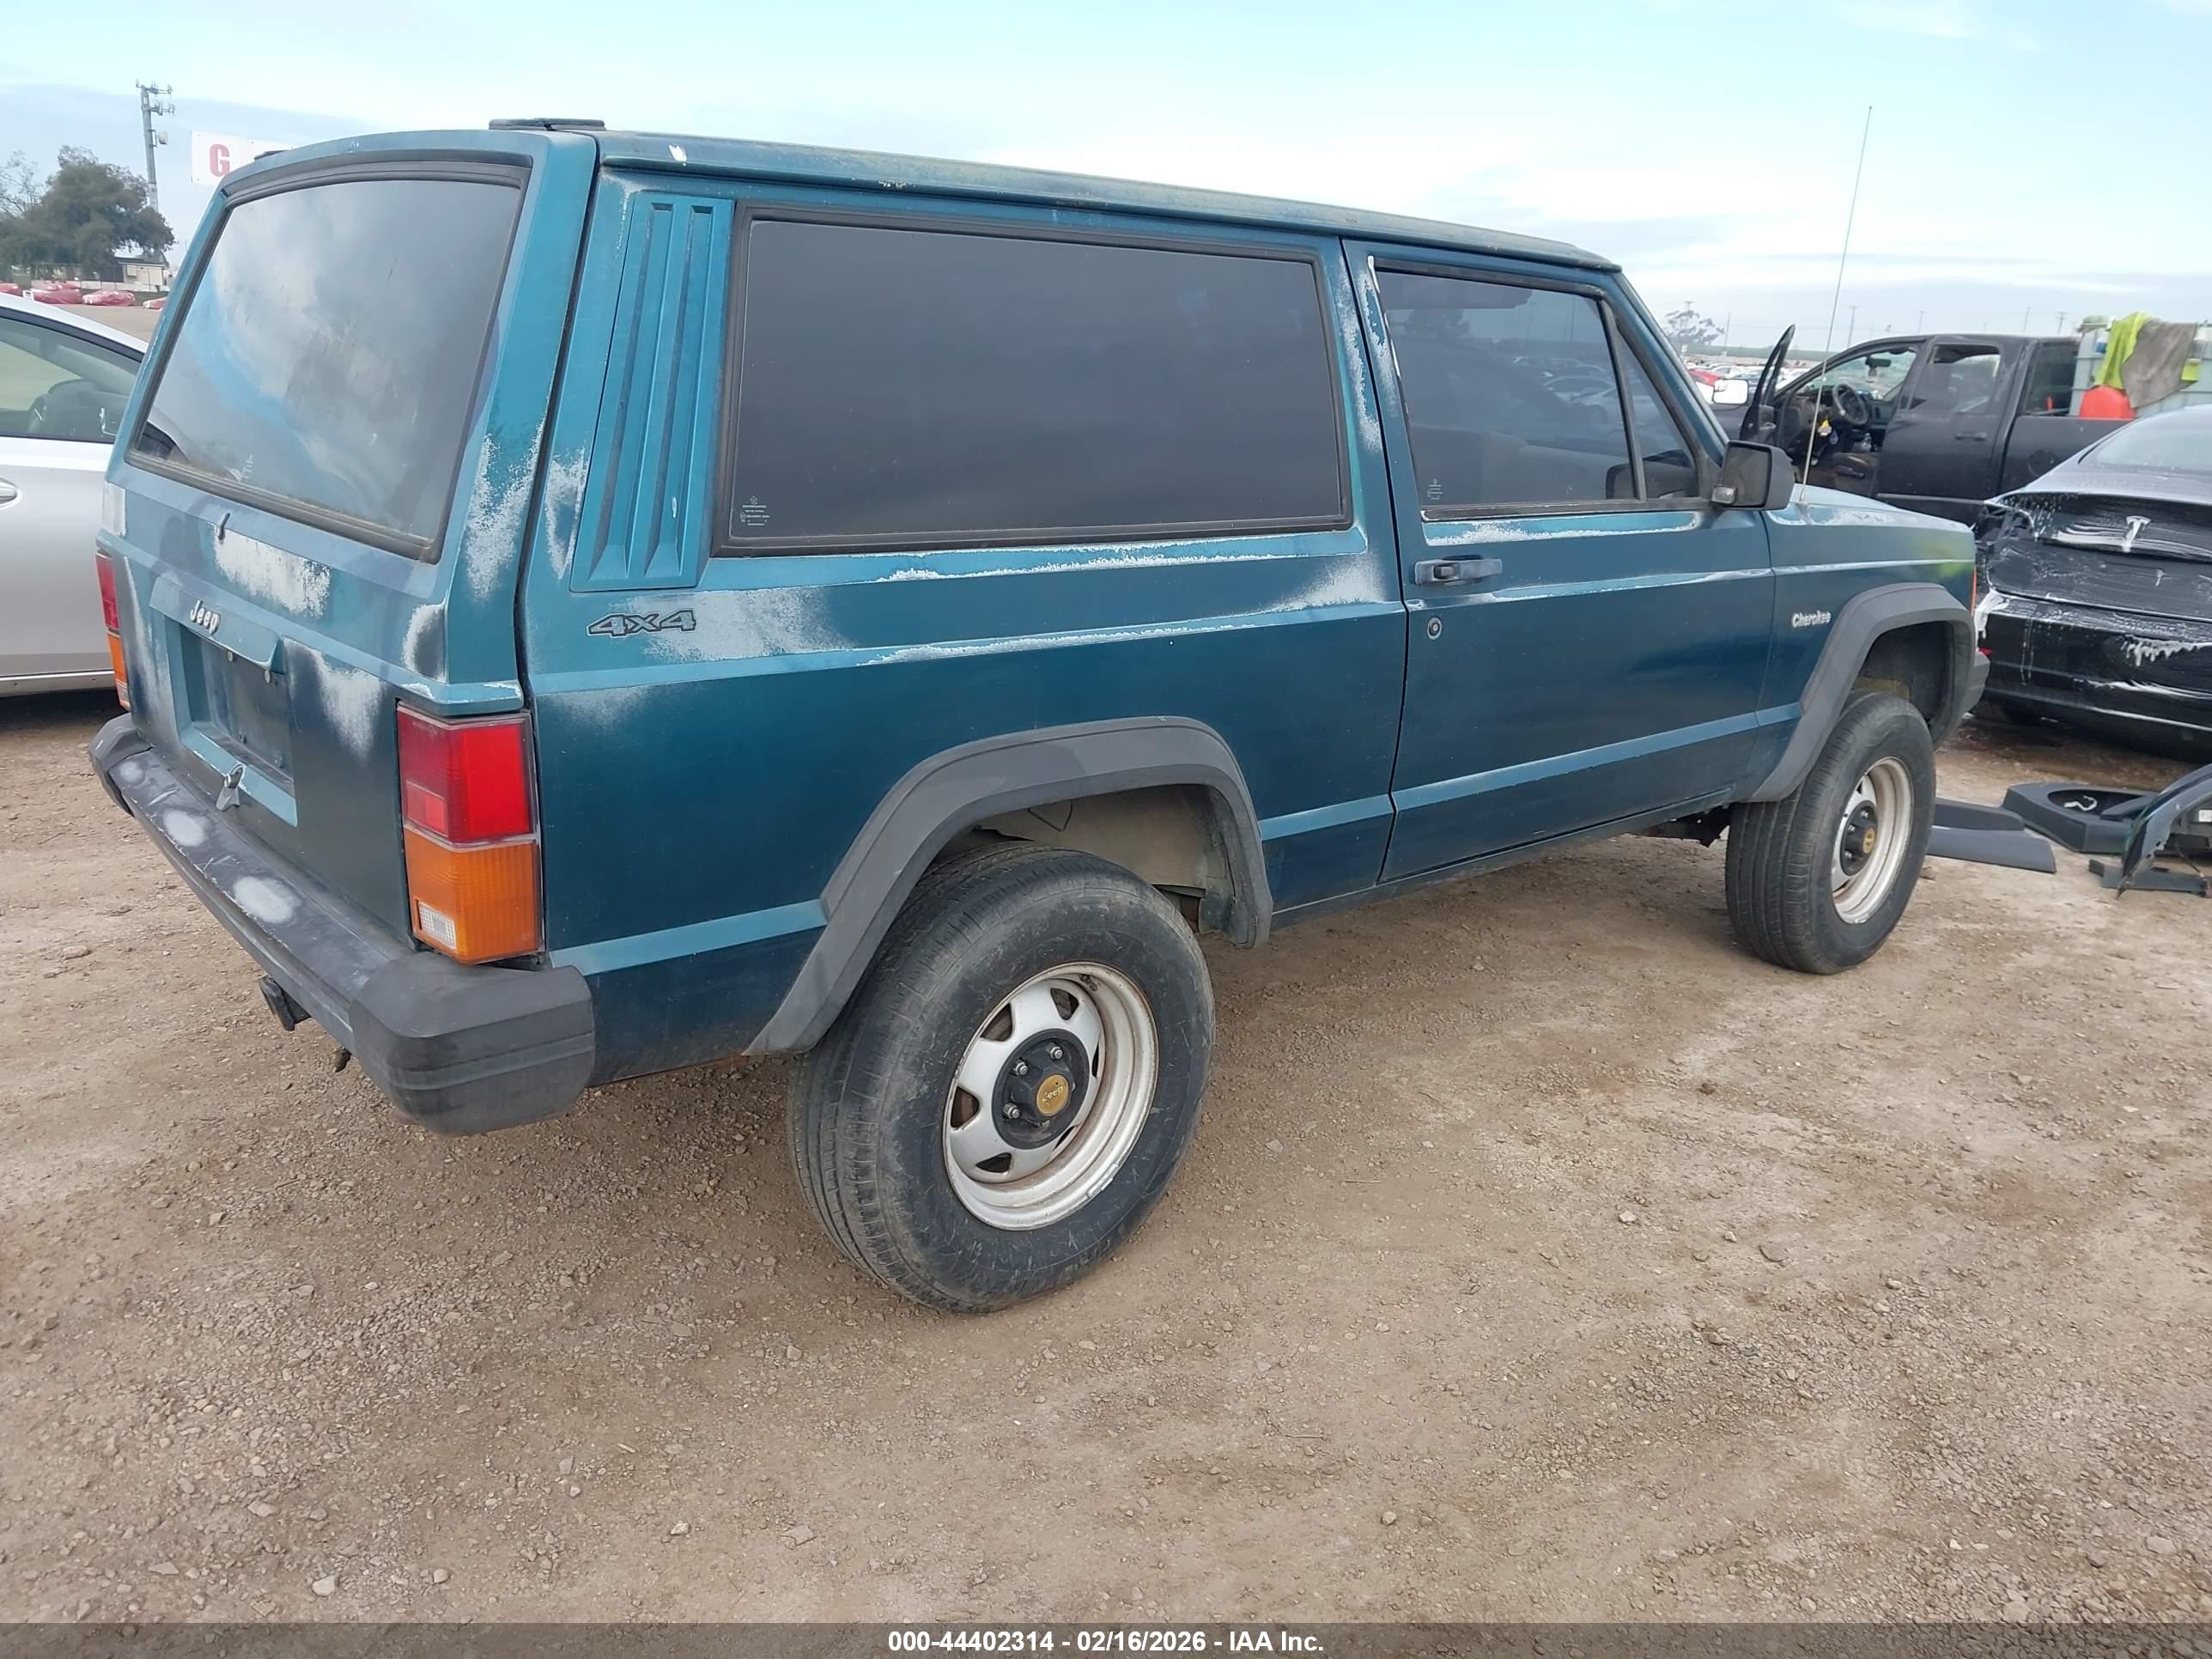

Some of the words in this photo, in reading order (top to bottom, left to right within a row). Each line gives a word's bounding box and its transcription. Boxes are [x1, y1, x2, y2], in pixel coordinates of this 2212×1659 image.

[210, 143, 230, 177] G
[190, 599, 221, 635] Jeep
[1792, 610, 1832, 628] Cherokee
